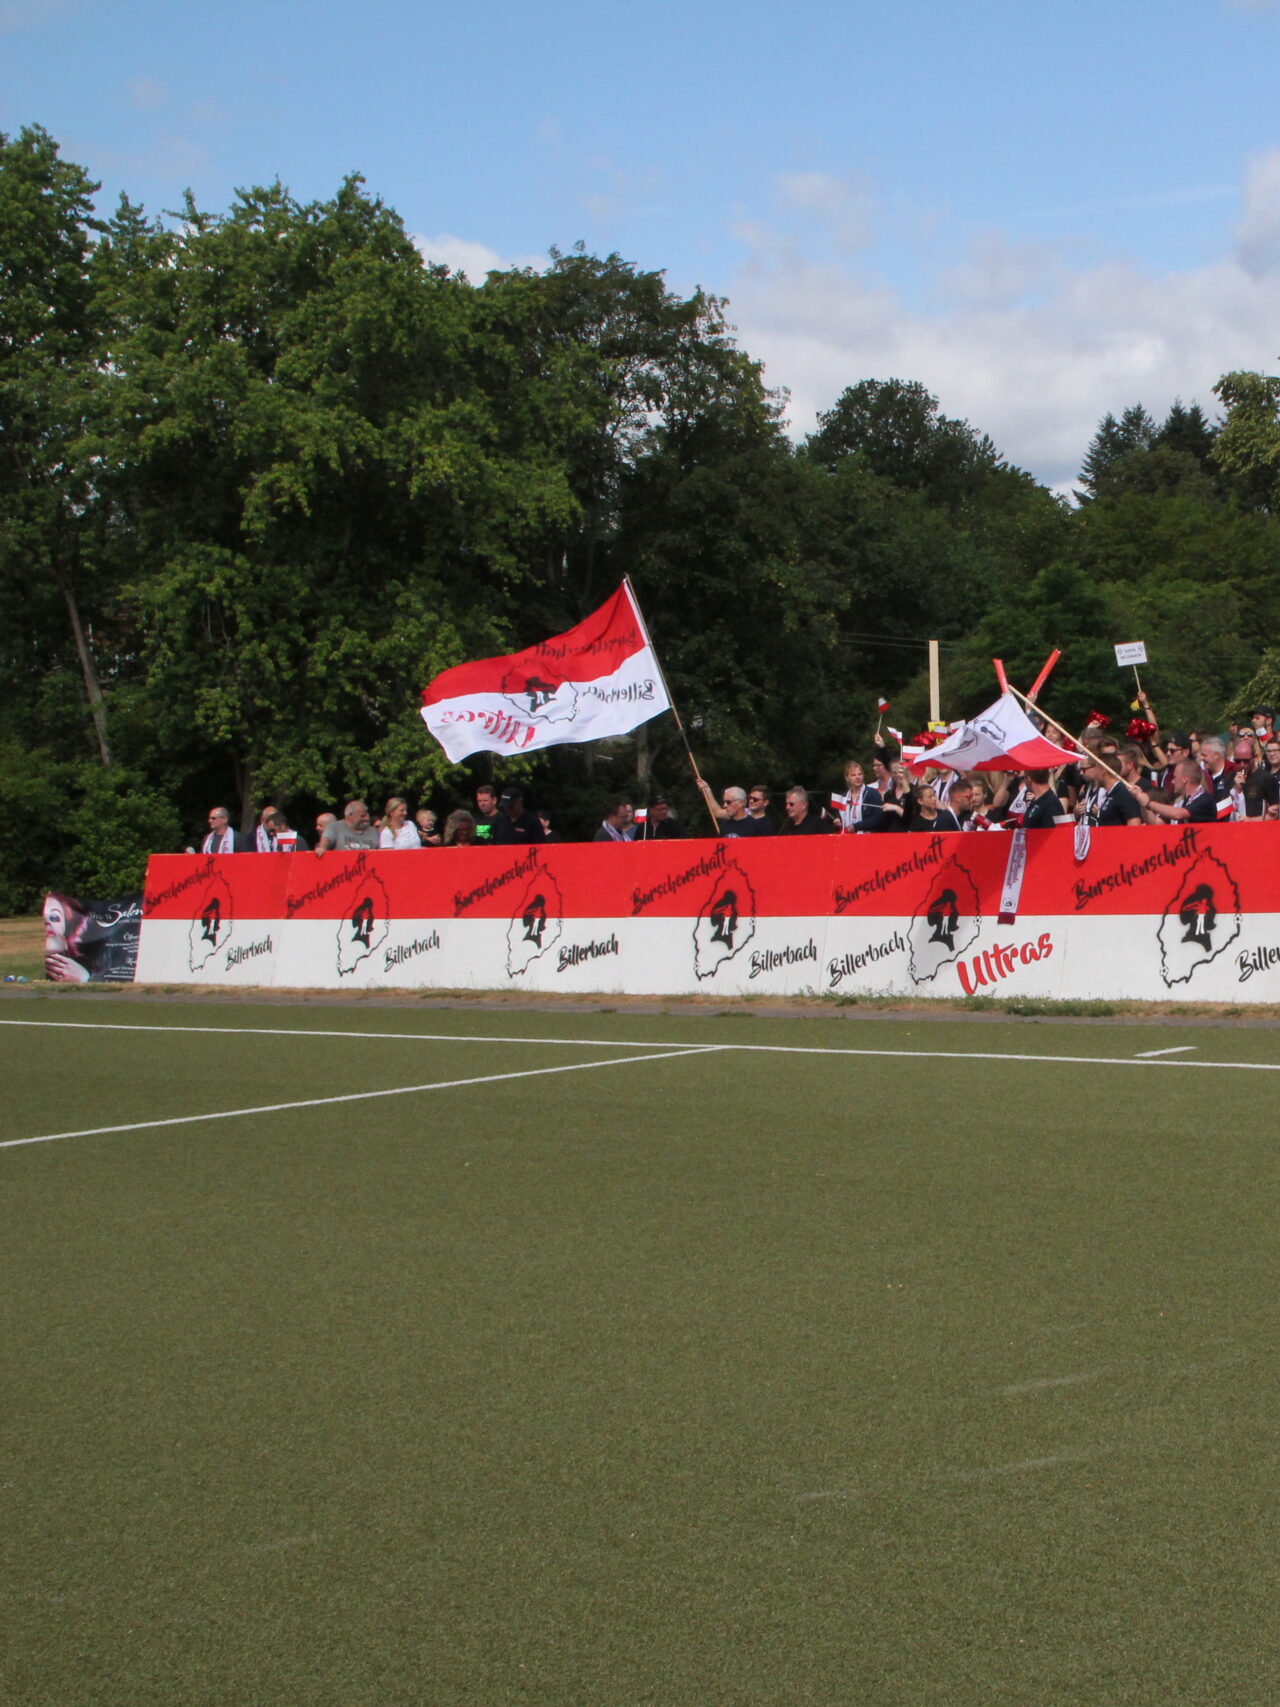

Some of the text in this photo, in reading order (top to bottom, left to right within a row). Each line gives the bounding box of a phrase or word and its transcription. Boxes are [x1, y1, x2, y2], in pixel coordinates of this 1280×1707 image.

[285, 852, 368, 919] Burschenschaft
[453, 847, 542, 917] Burschenschaft
[631, 842, 728, 915] Burschenschaft
[832, 836, 947, 914] Burschenschaft
[1072, 827, 1202, 910] Burschenschaft
[225, 935, 273, 971] Billerbach
[383, 929, 440, 973] Billerbach
[556, 932, 619, 973] Billerbach
[748, 937, 818, 979] Billerbach
[827, 931, 906, 988] Billerbach
[956, 932, 1054, 995] Ultras
